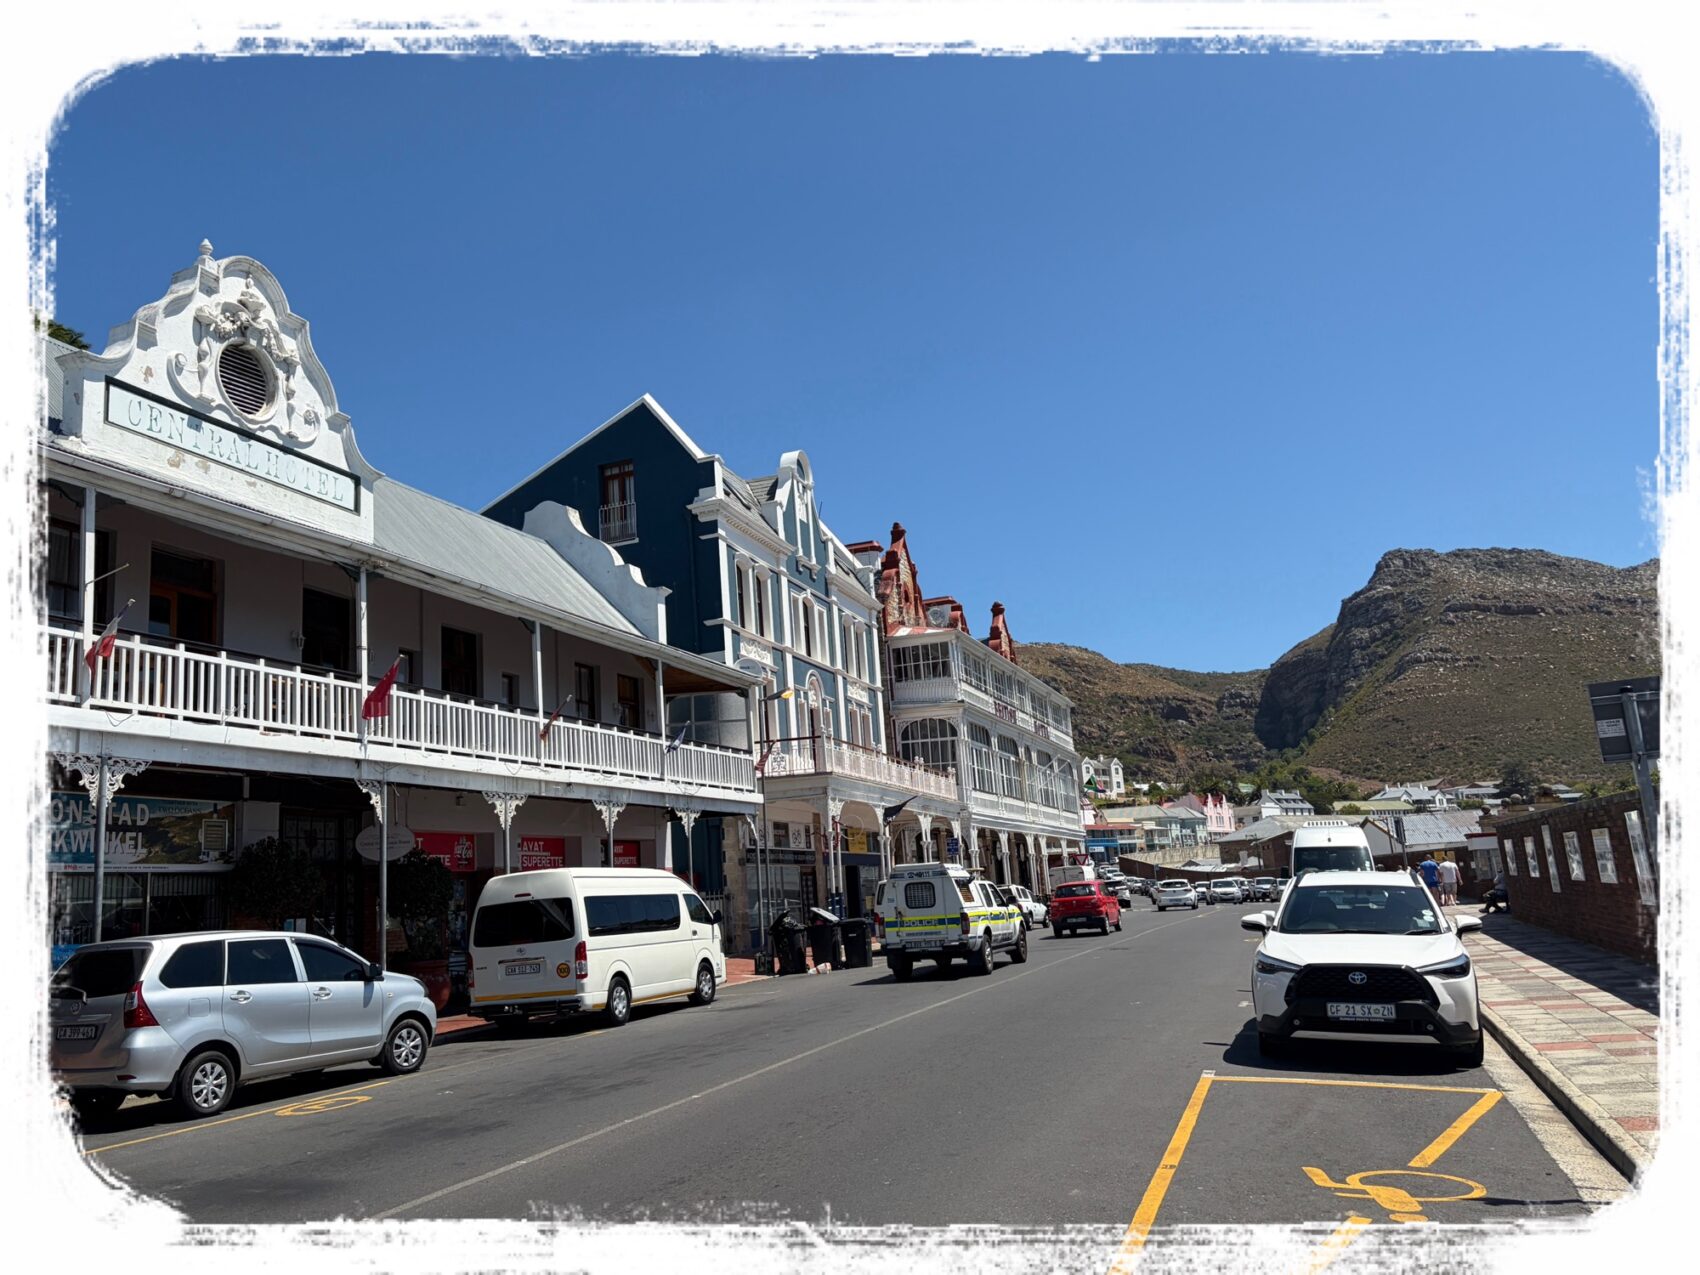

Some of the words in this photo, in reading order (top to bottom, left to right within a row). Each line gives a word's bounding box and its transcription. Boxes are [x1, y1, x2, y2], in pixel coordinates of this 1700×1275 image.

[127, 398, 260, 471] CENTRAL
[265, 450, 345, 502] HOTEL
[522, 841, 544, 852] AYAT
[522, 857, 563, 867] SUPERETTE
[614, 857, 637, 865] SUPERETTE
[1330, 1004, 1341, 1015] CF
[1345, 1005, 1356, 1016] 21
[1360, 1005, 1372, 1016] SX
[1381, 1006, 1393, 1017] ZN
